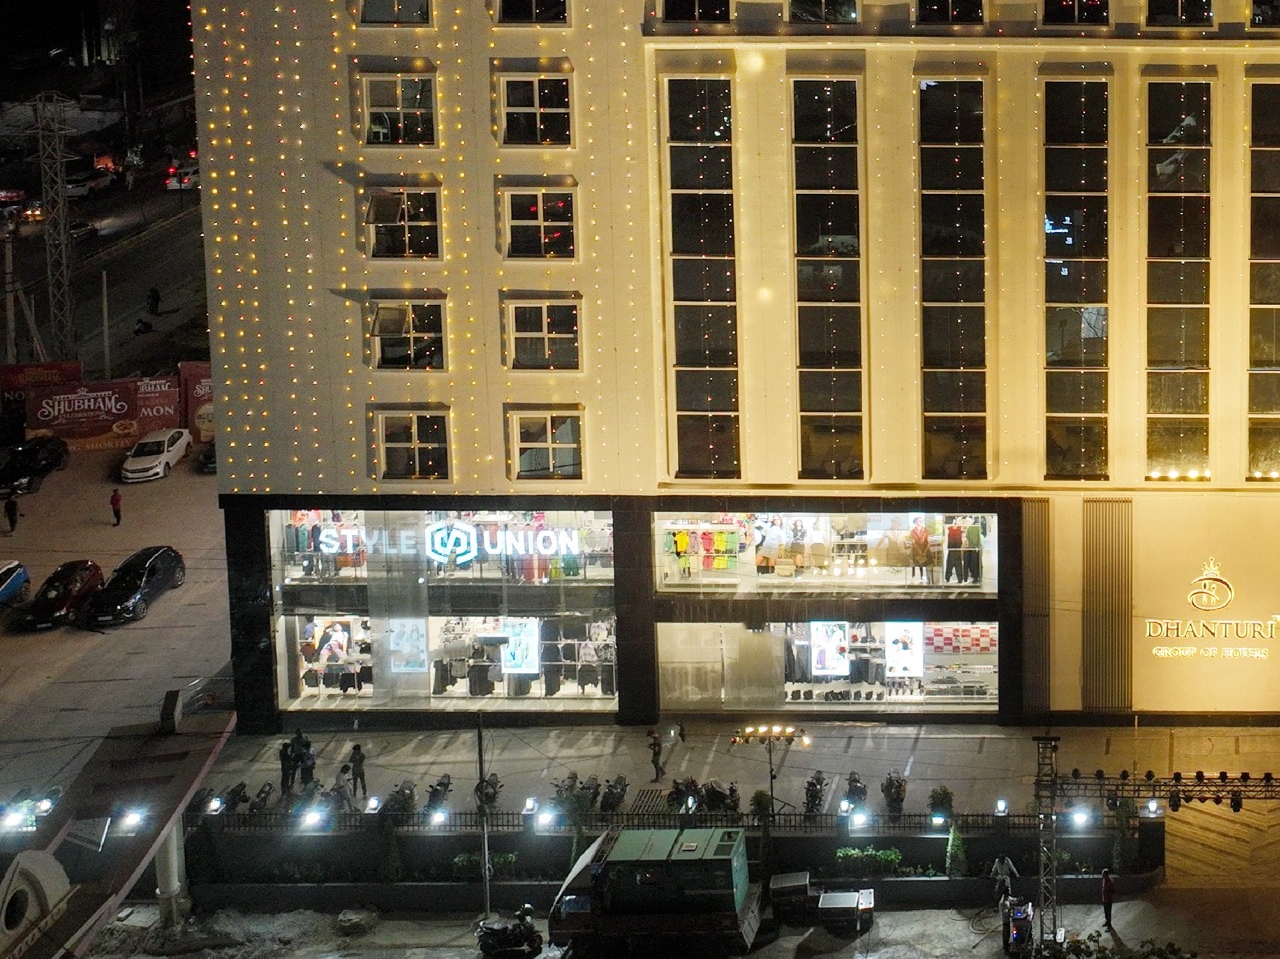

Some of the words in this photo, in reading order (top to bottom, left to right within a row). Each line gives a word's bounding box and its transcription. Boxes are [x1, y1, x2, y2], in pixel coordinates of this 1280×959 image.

[37, 394, 128, 420] SHUBHAM
[319, 528, 417, 554] STYLE
[483, 530, 580, 555] UNION
[1145, 619, 1277, 640] DHANTURI
[1152, 646, 1197, 658] GROUP
[1200, 647, 1218, 658] OF
[1221, 647, 1269, 660] HOTELS
